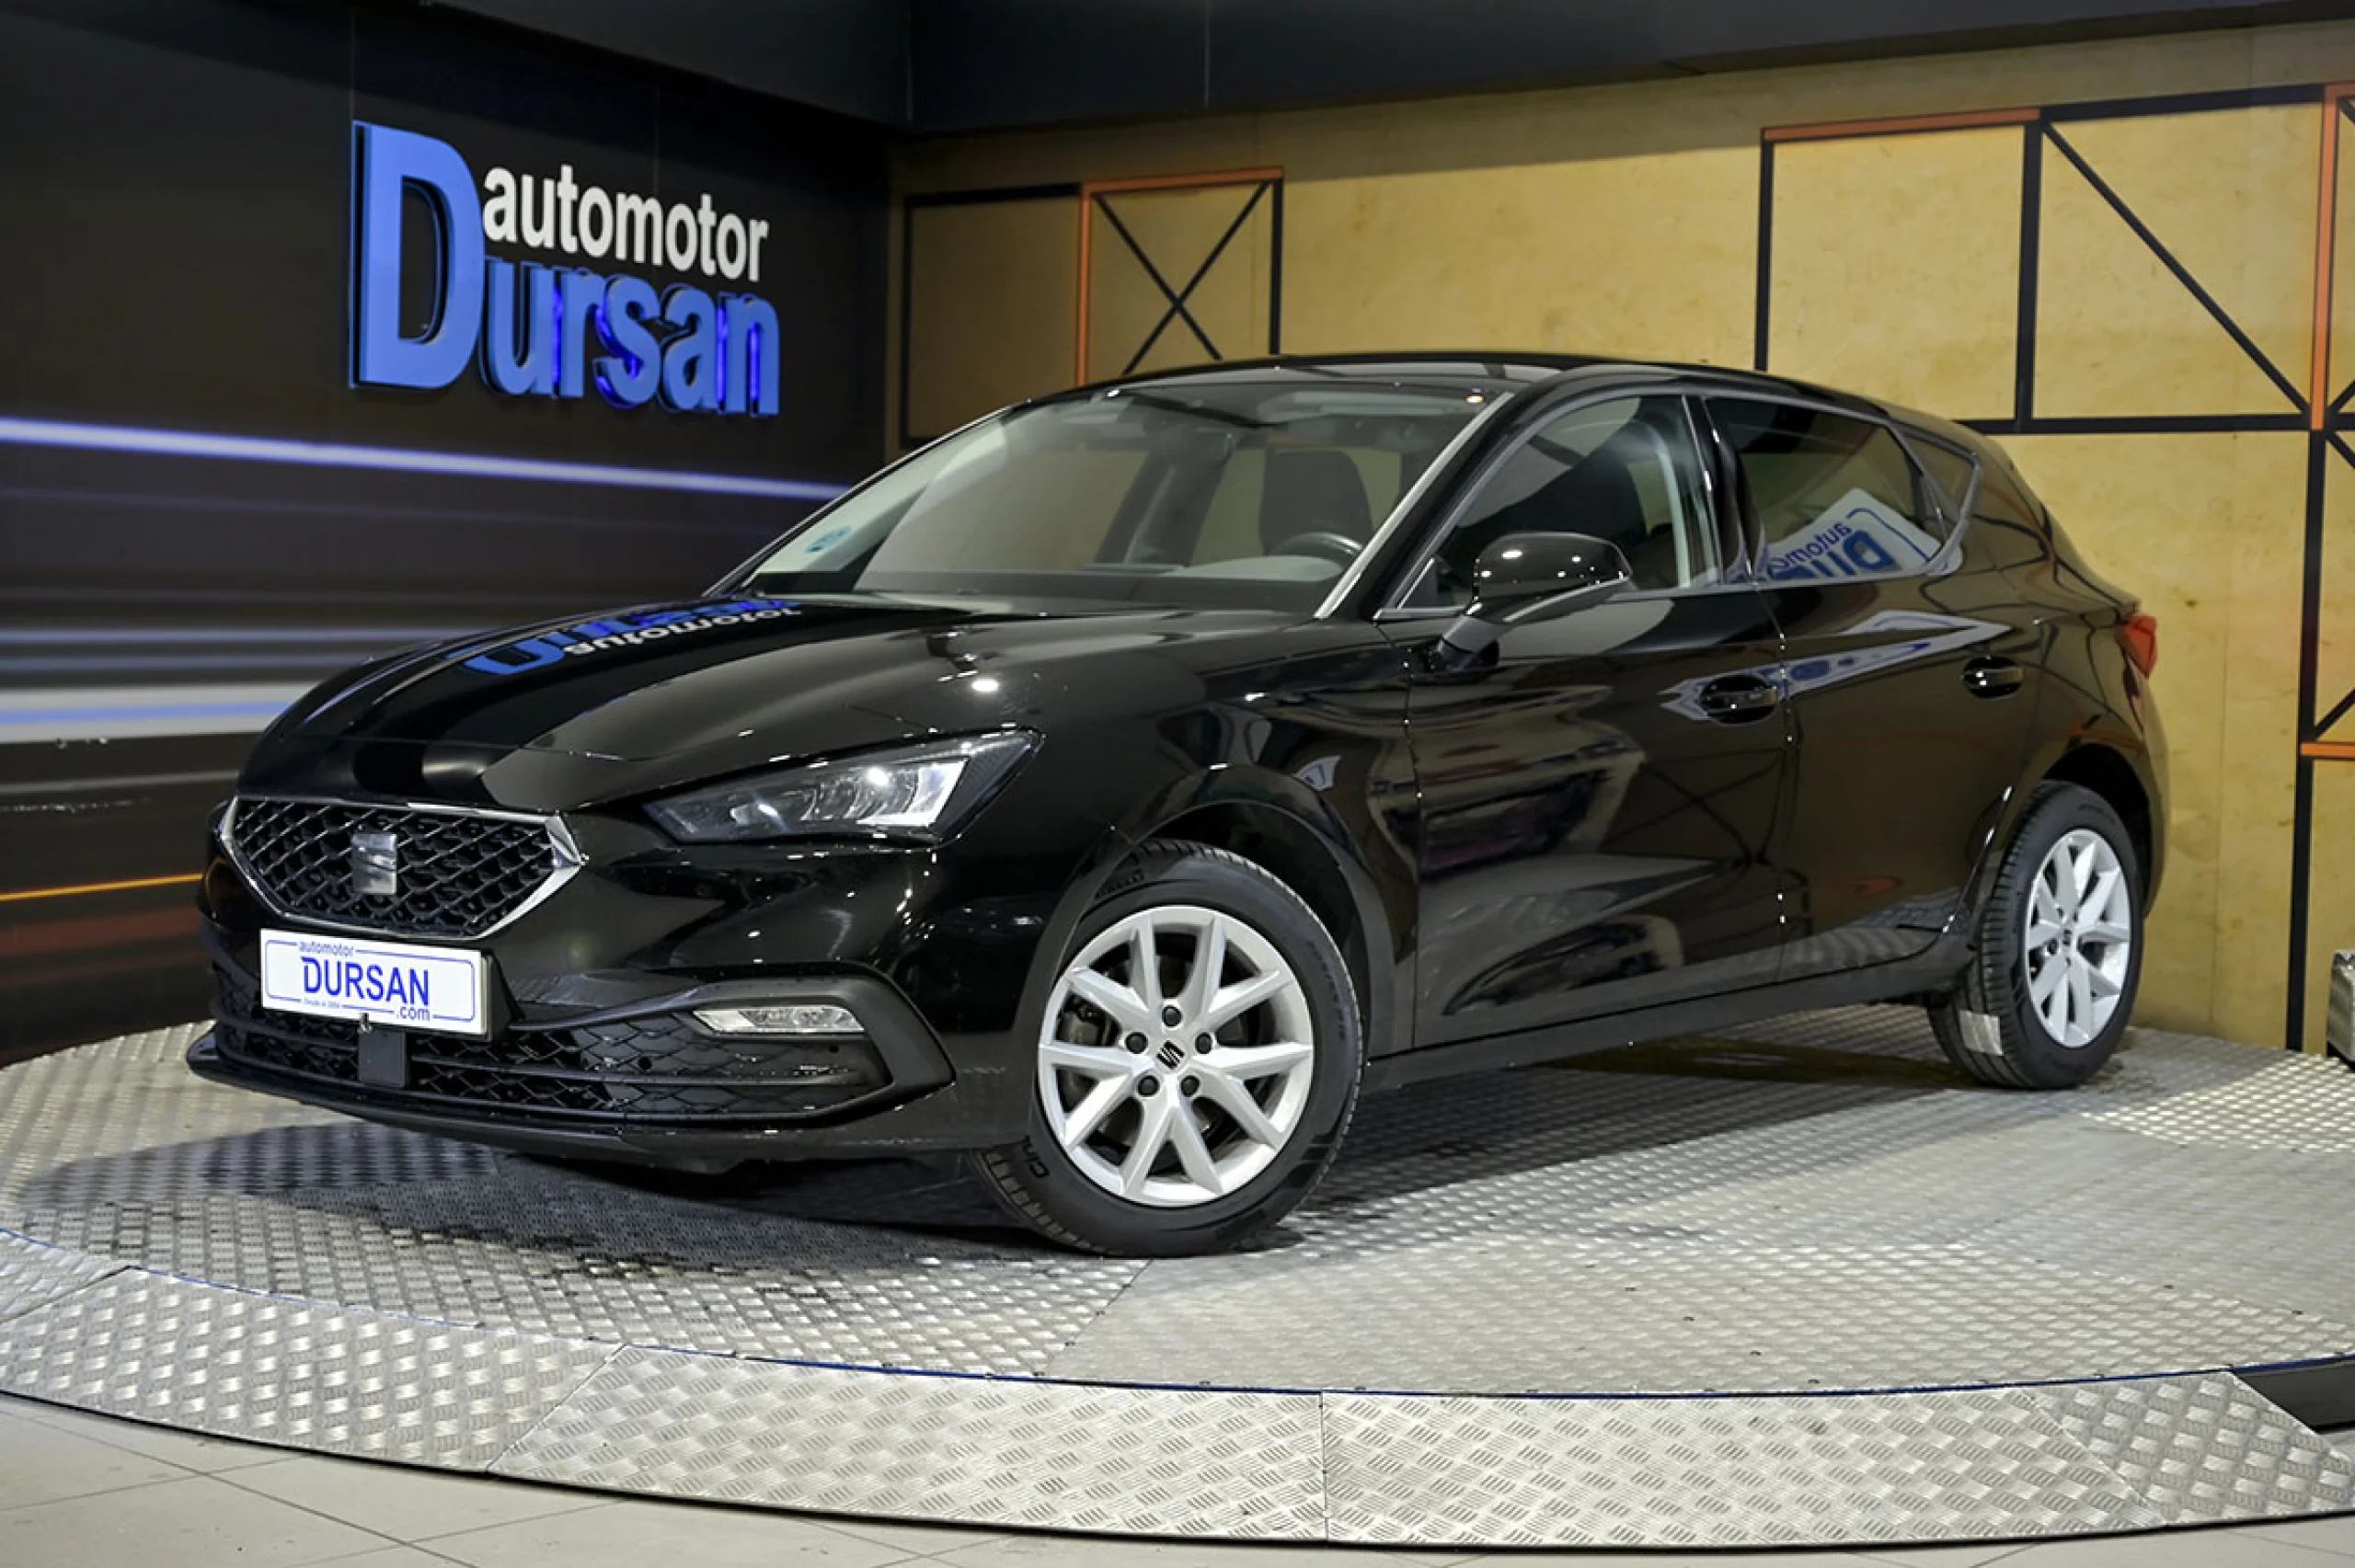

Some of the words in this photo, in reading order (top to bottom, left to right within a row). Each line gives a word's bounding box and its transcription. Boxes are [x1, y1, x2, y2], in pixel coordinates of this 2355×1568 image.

[483, 165, 769, 281] automotor
[350, 120, 780, 418] Dursan
[298, 940, 355, 957] automotor
[300, 956, 430, 1007] DURSAN
[396, 1004, 431, 1022] .com
